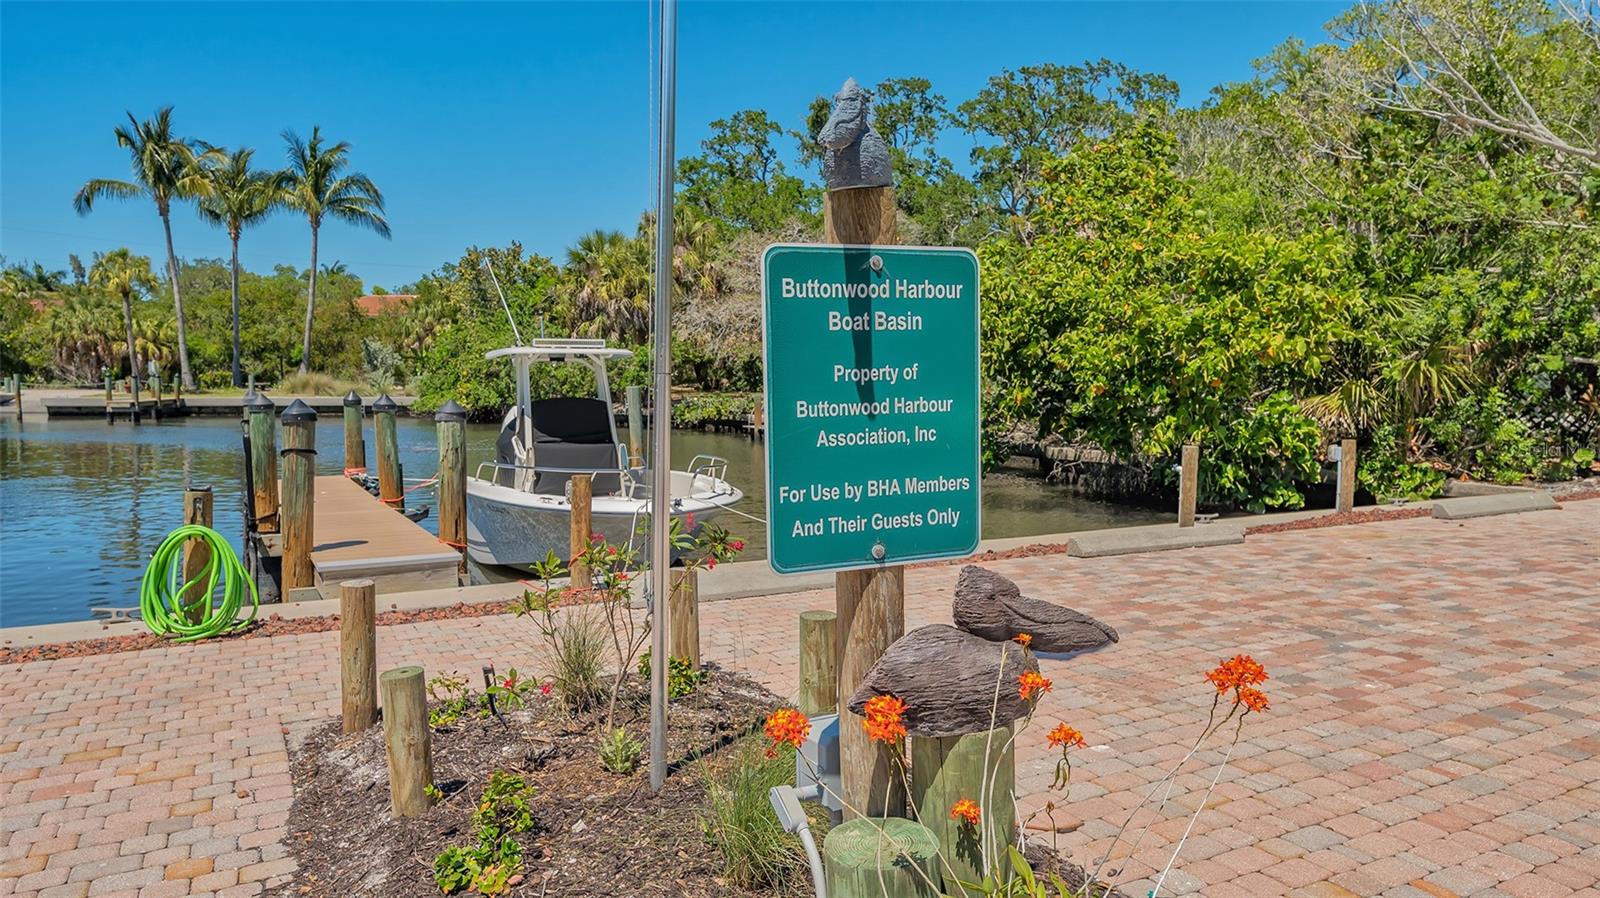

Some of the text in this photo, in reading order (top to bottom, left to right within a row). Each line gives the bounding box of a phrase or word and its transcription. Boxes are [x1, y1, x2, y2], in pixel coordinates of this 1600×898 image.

[782, 278, 962, 298] Buttonwood Harbour
[829, 312, 922, 331] Boat Basin
[834, 364, 918, 385] Property of
[797, 397, 953, 418] Buttonwood Harbour
[817, 426, 936, 447] Association, Inc
[779, 476, 969, 503] For Use by BHA Members
[792, 508, 960, 537] And Their Guests Only
